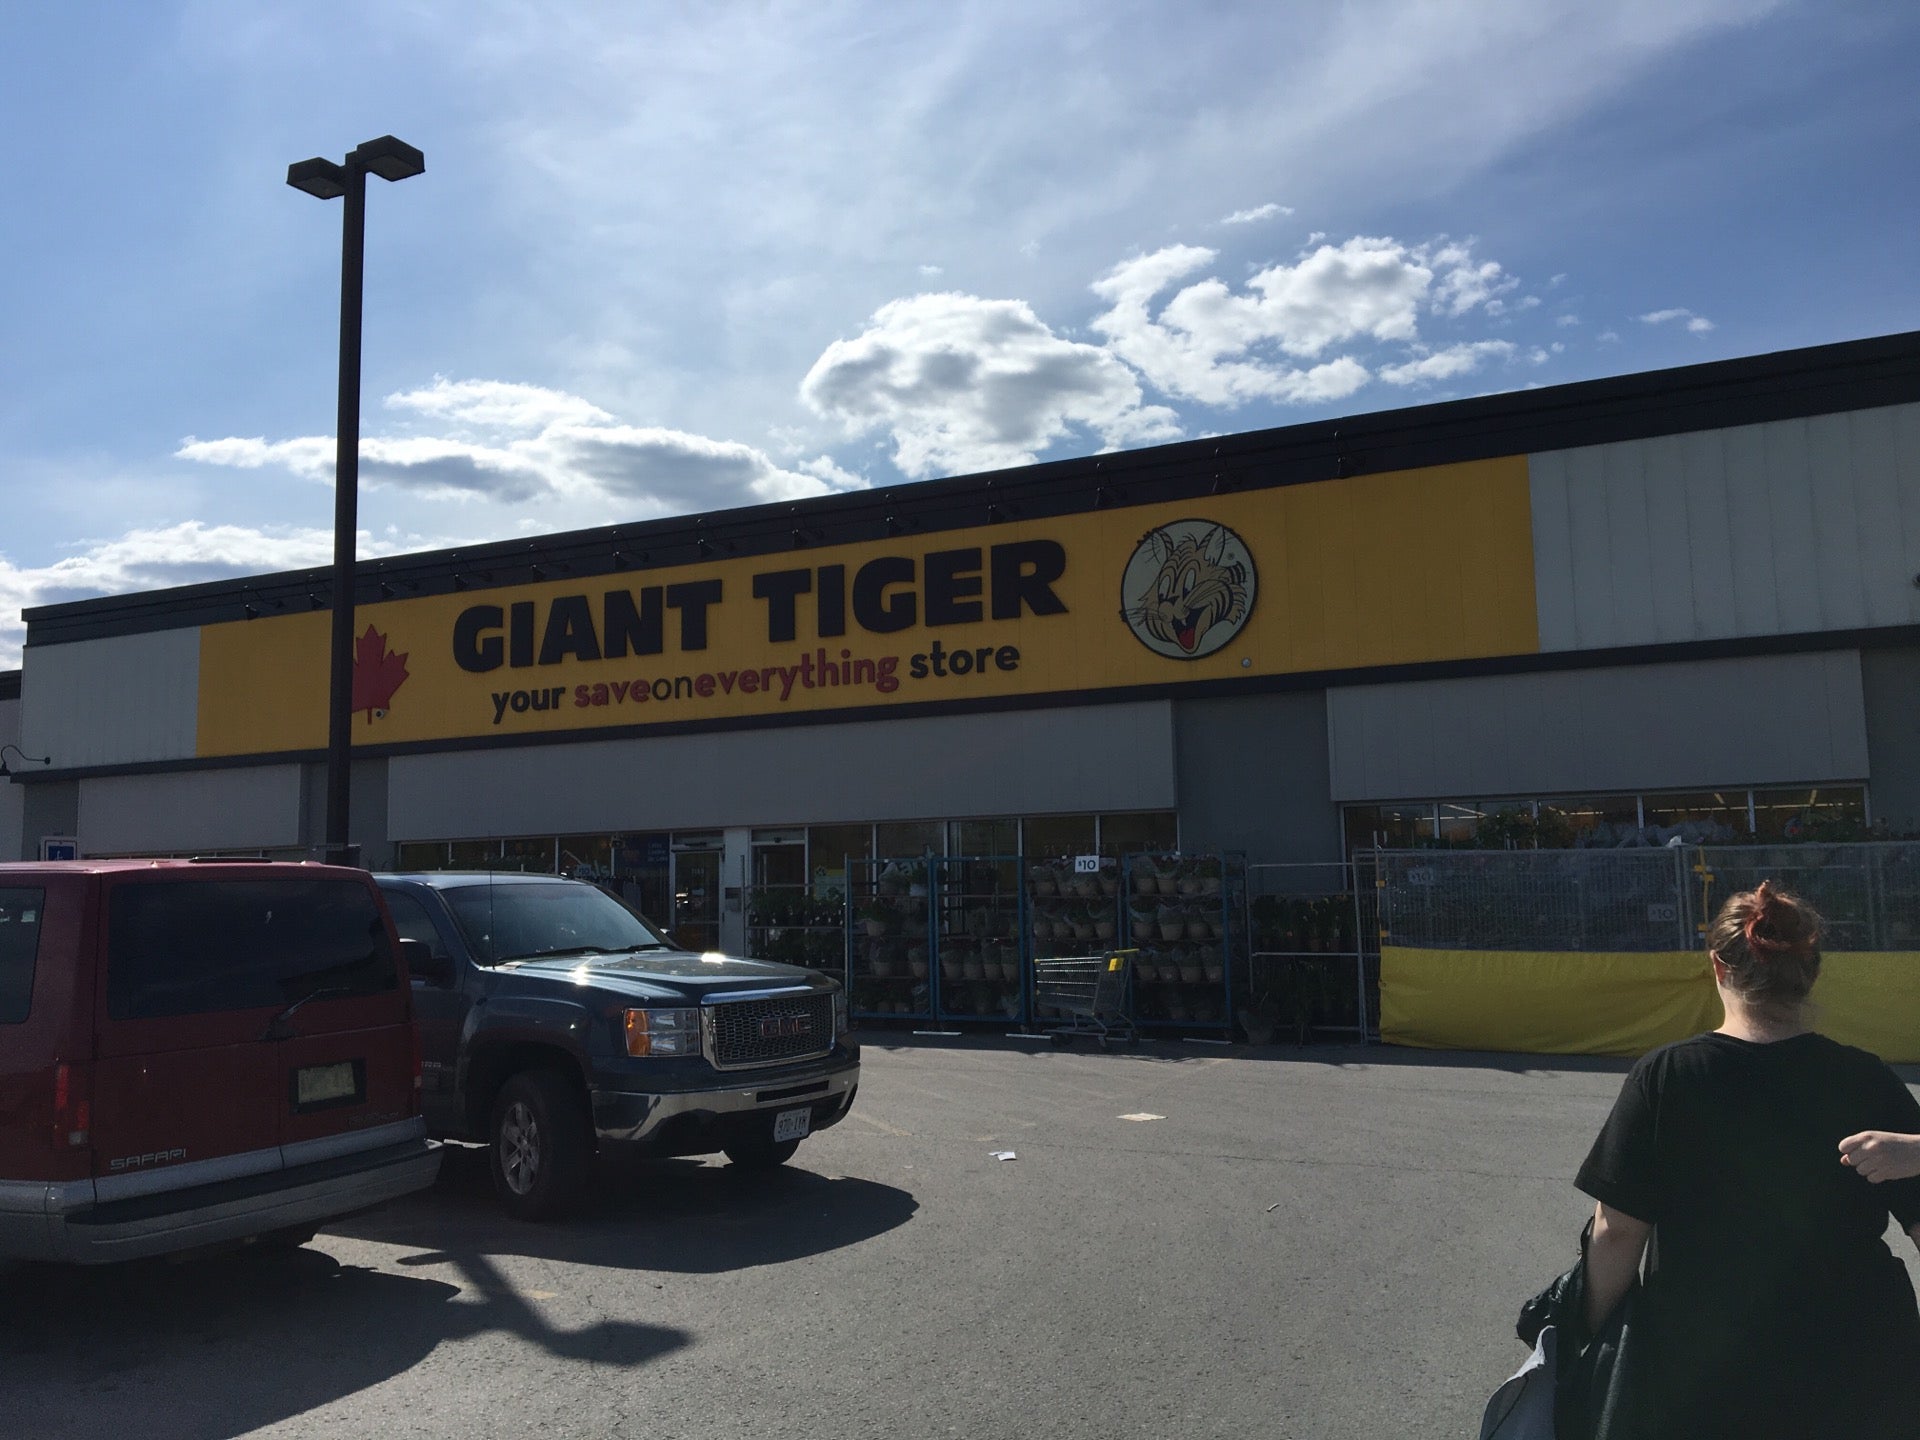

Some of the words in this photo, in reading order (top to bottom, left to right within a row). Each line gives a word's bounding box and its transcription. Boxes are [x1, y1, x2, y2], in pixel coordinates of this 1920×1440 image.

[453, 579, 723, 673] GIANT
[753, 540, 1070, 643] TIGER
[492, 686, 565, 724] your
[574, 648, 900, 708] saveoneverything
[910, 640, 1020, 679] store
[1078, 859, 1096, 870] $10
[761, 1014, 811, 1037] GMC
[110, 1148, 187, 1170] SAFARI
